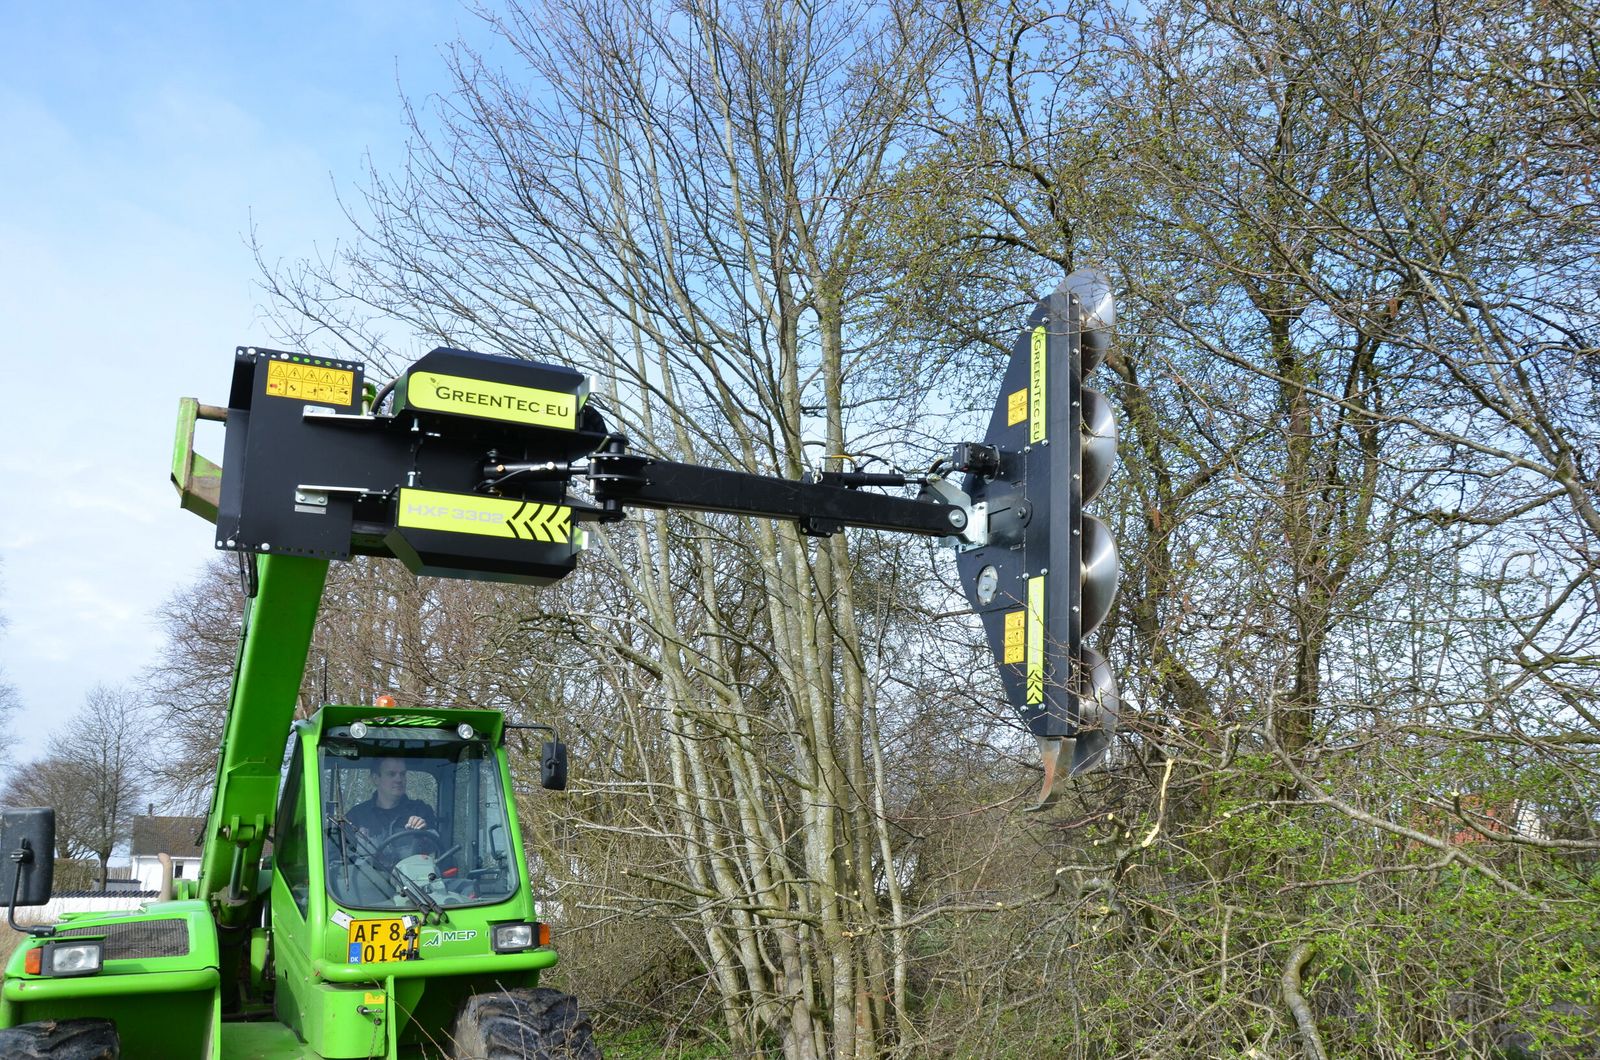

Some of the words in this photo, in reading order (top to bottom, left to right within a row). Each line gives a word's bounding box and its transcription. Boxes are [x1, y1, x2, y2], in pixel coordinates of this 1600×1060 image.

[407, 503, 449, 518] HXF
[451, 507, 505, 524] 3302
[354, 923, 382, 942] AF
[364, 943, 403, 962] 014
